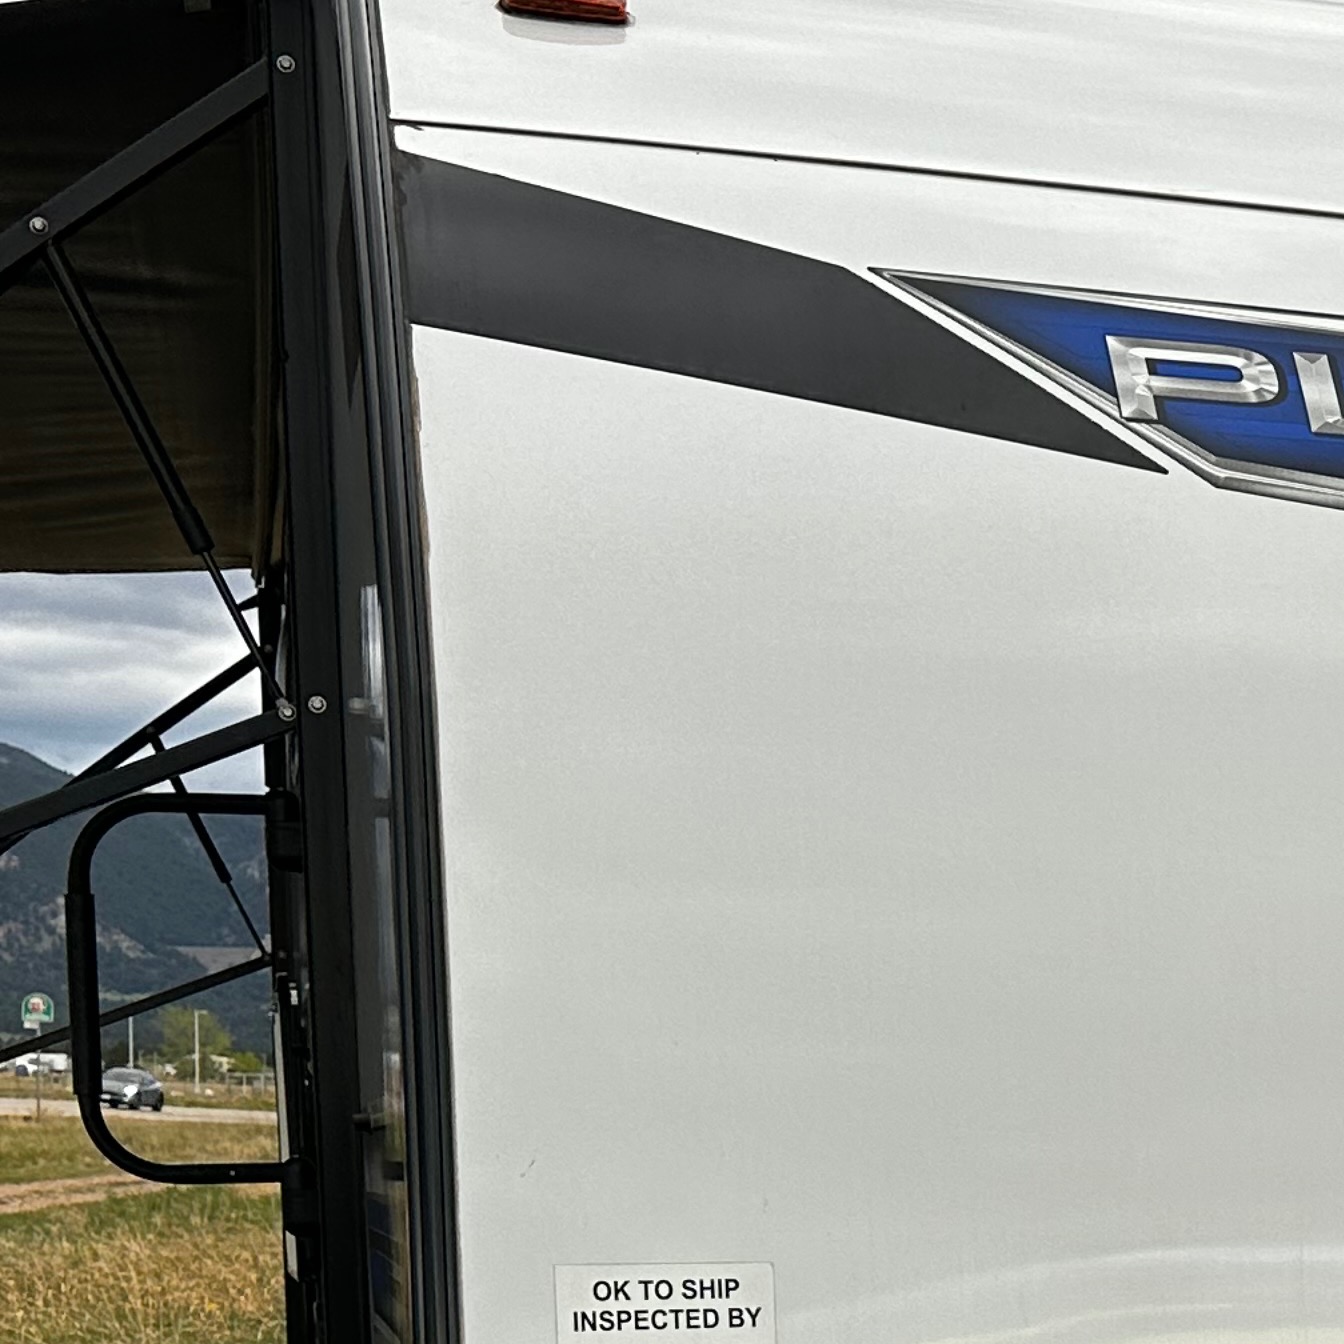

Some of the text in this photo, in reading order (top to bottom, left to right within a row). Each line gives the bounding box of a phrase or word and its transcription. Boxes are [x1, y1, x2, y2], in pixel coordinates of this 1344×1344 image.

[593, 1278, 740, 1301] OK TO SHIP
[573, 1306, 762, 1332] INSPECTED BY
